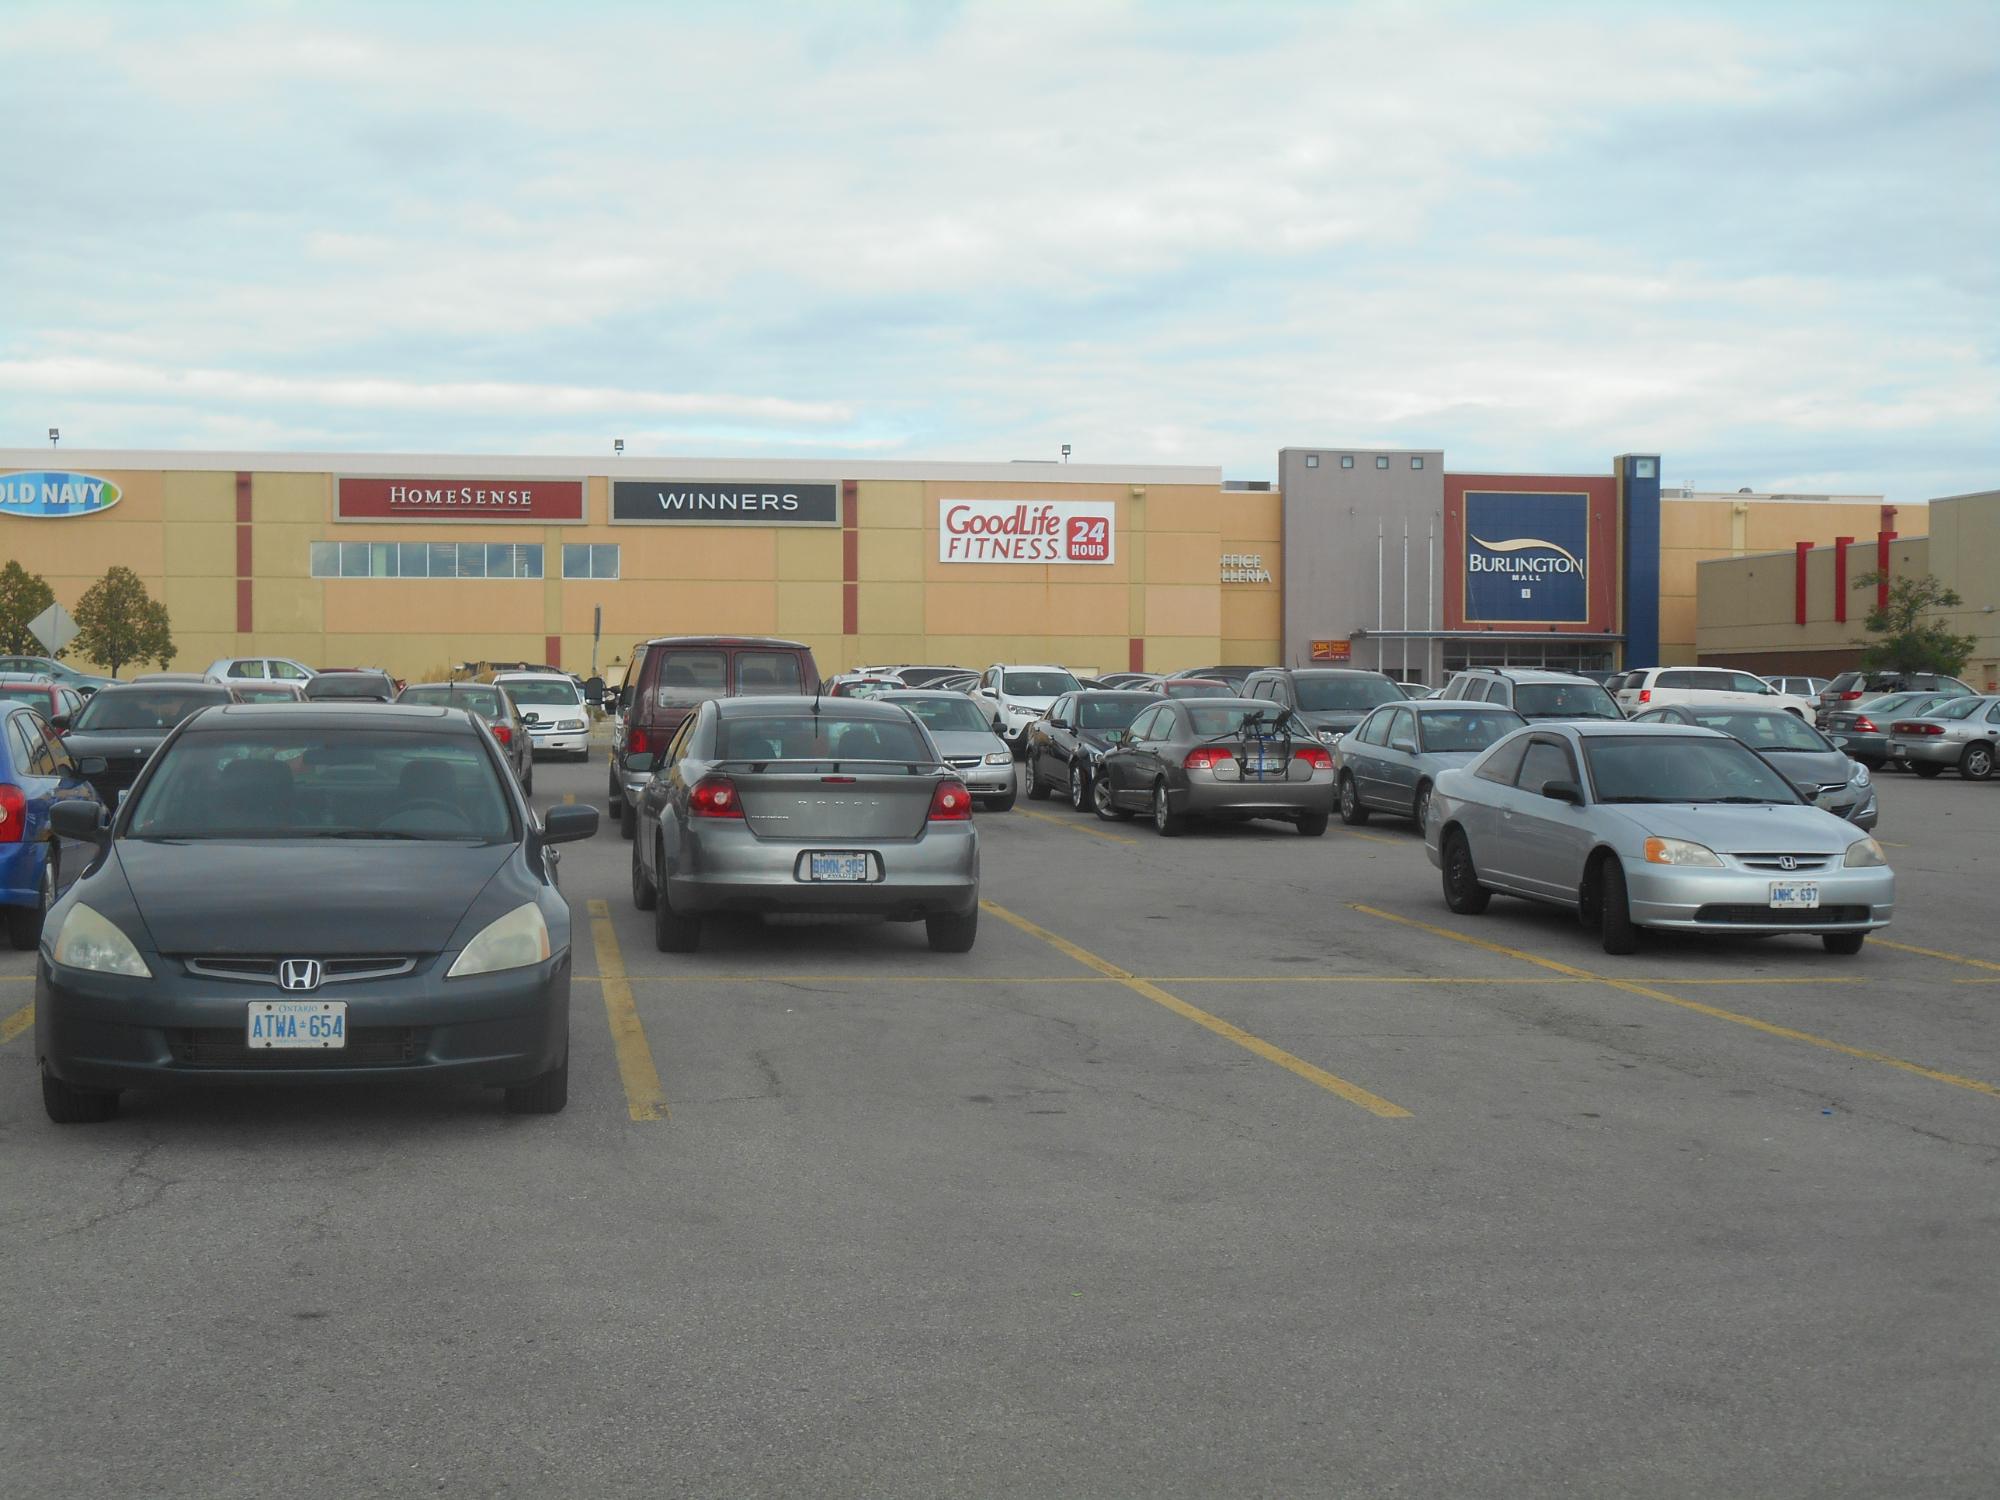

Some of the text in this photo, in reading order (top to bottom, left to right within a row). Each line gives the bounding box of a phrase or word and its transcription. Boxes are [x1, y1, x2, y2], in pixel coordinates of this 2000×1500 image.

[41, 483, 104, 504] NAVY
[658, 493, 799, 511] WINNERS
[1071, 521, 1105, 543] 24
[948, 537, 1059, 560] FITNESS
[1071, 544, 1104, 556] HOUR
[1220, 554, 1262, 568] FFICE
[1511, 574, 1541, 582] MALL
